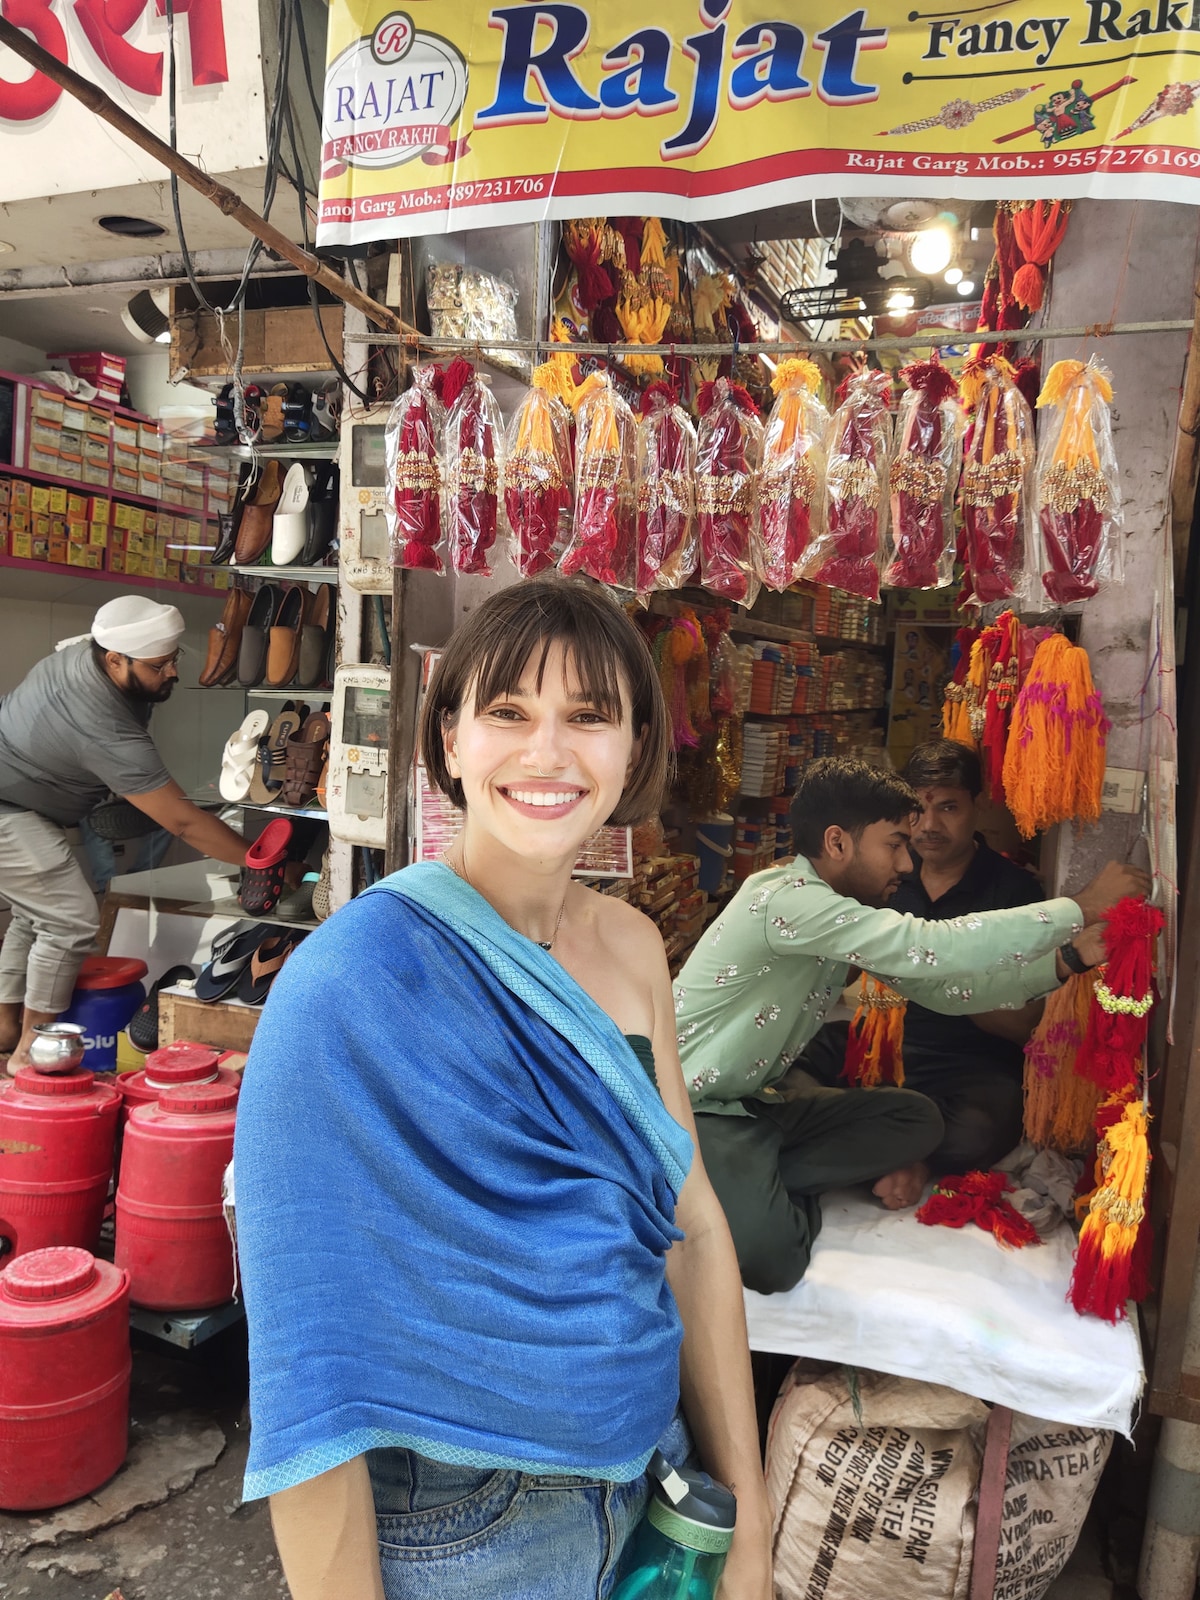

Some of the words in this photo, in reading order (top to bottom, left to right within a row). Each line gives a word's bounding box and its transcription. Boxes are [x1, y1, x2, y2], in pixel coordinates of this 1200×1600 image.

[377, 22, 410, 55] R
[922, 15, 1070, 65] Fancy
[334, 71, 445, 123] RAJAT
[474, 0, 889, 160] Rajat
[332, 129, 386, 157] FANCY
[388, 127, 439, 148] RAKHI
[845, 152, 906, 172] Rajat
[912, 155, 970, 174] Garg
[975, 155, 1045, 170] Mob.:
[1053, 148, 1200, 168] 9557276169
[360, 199, 396, 216] Garg
[399, 190, 442, 210] Mob.:
[446, 178, 544, 202] 9897231706
[825, 1425, 861, 1467] CKED
[847, 1440, 879, 1483] BEFORE
[867, 1427, 911, 1498] PRODUCE
[1053, 1452, 1090, 1478] TEA
[862, 1490, 884, 1515] OF
[1002, 1493, 1028, 1521] ADE
[850, 1506, 878, 1544] INDIA
[879, 1509, 905, 1541] TEA
[902, 1526, 933, 1565] PACK
[1032, 1535, 1069, 1572] WEIGHT
